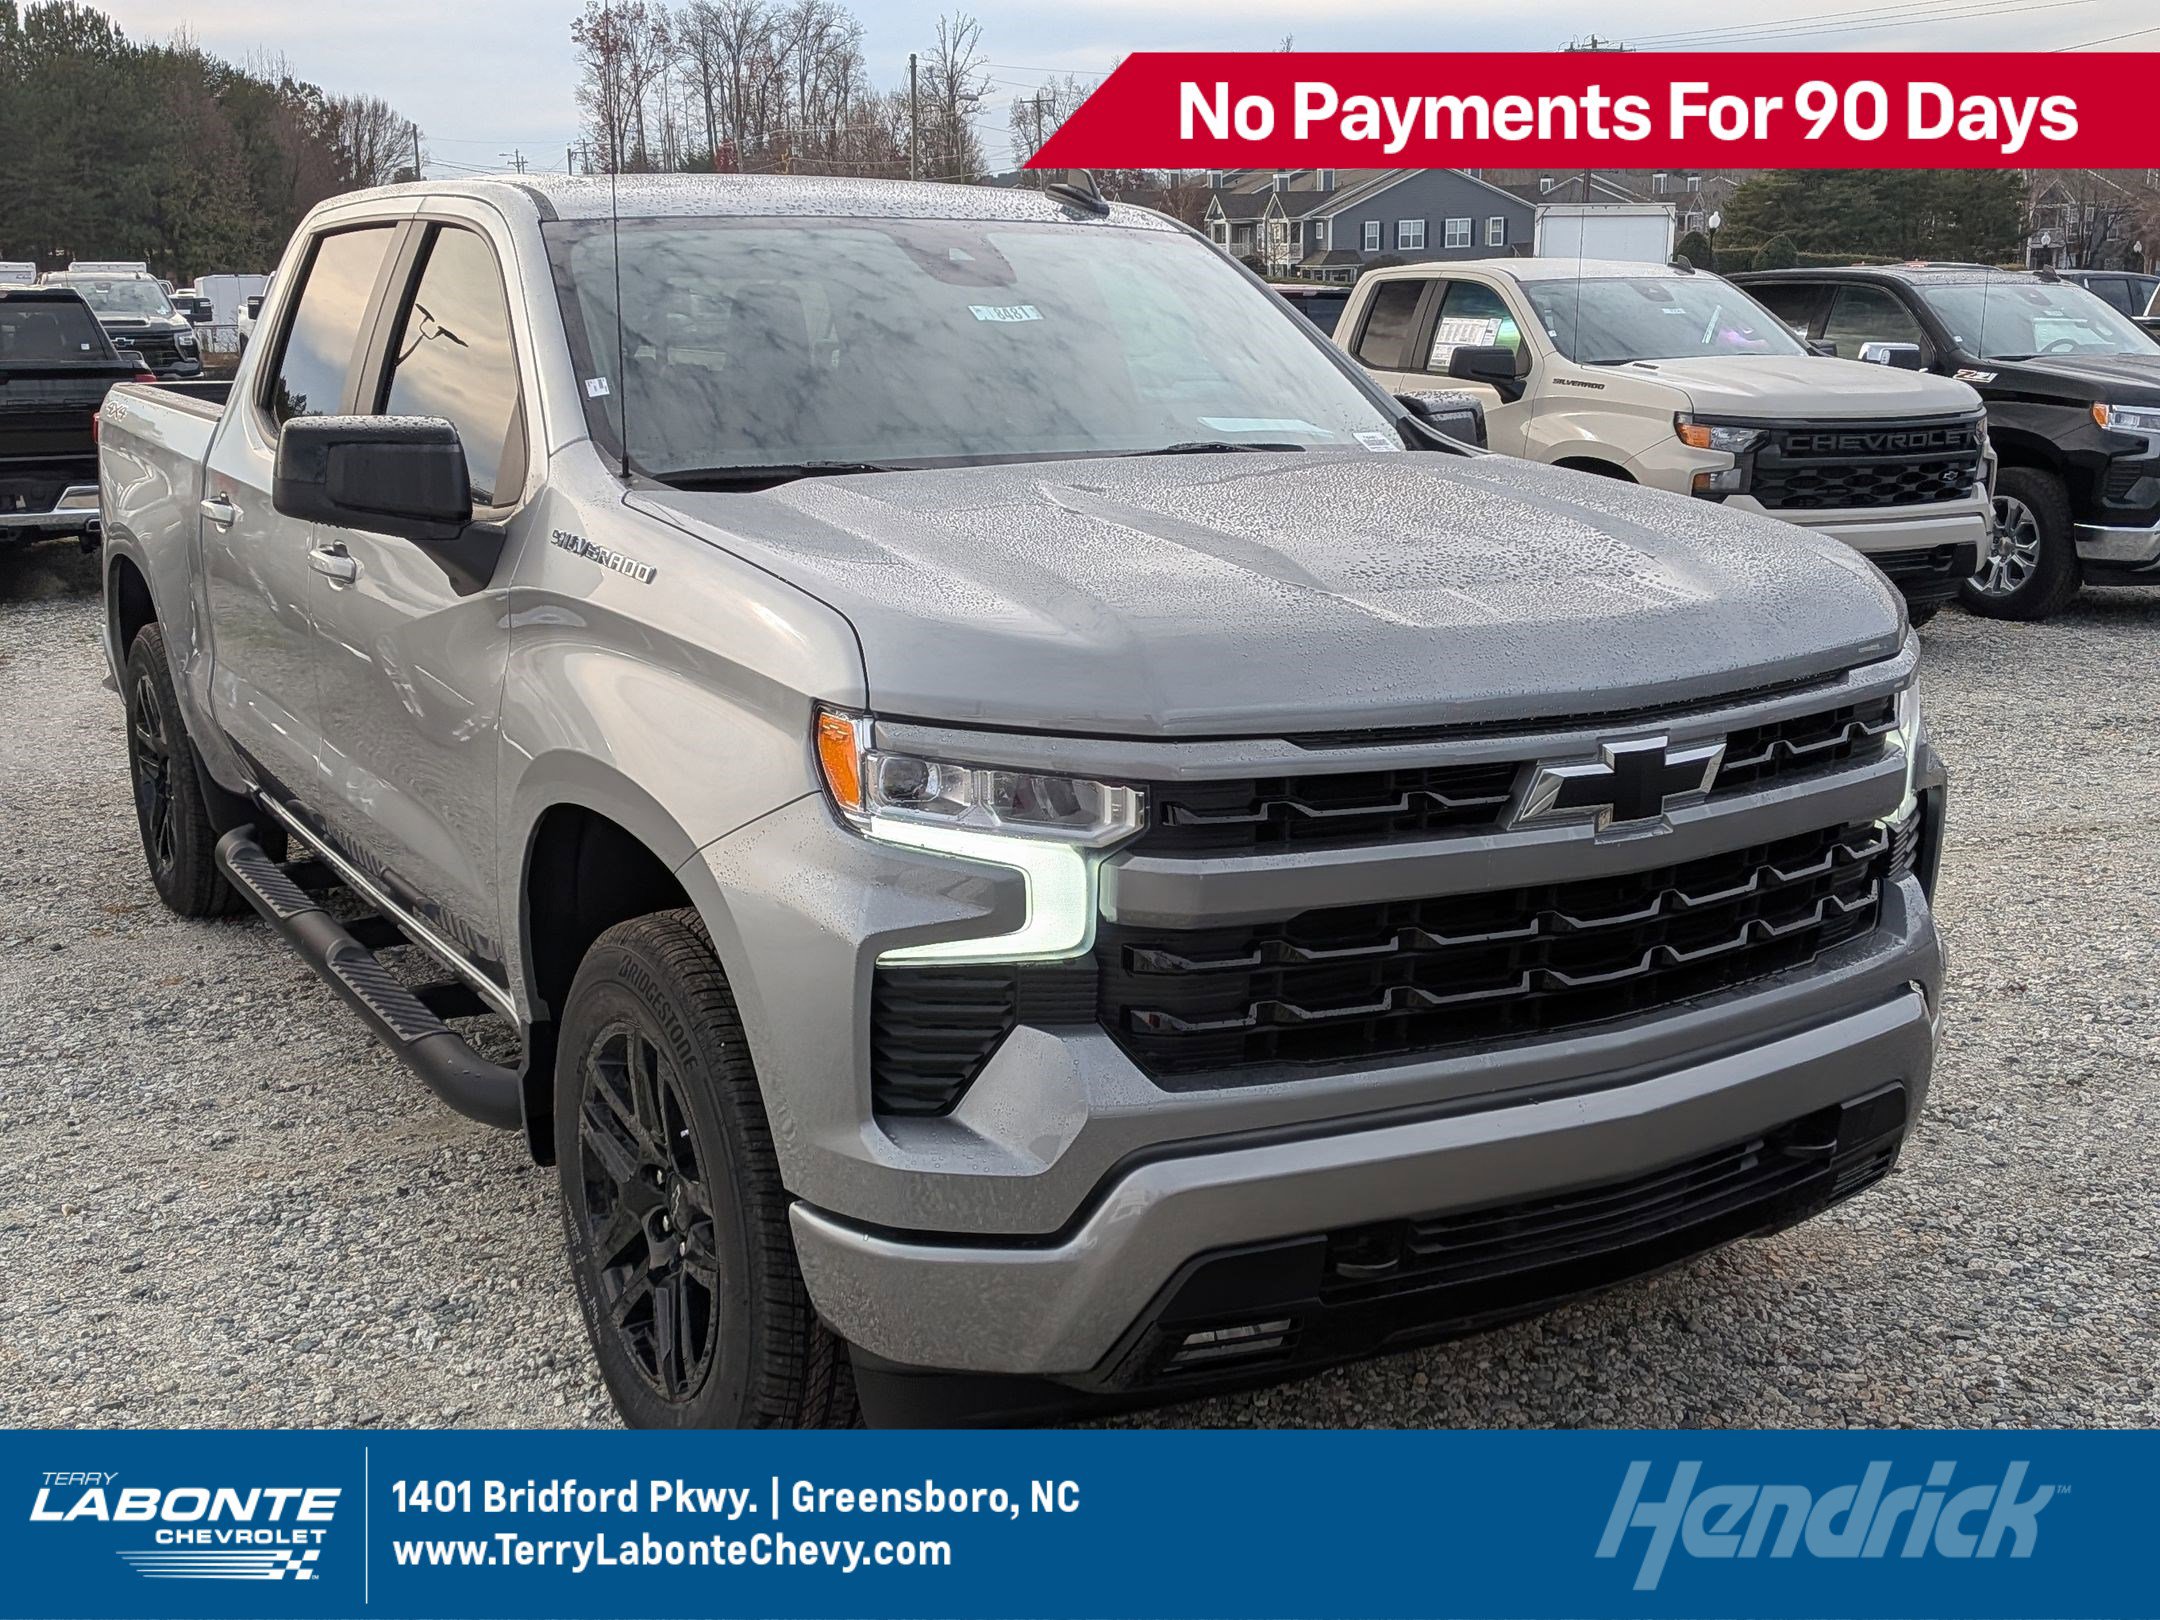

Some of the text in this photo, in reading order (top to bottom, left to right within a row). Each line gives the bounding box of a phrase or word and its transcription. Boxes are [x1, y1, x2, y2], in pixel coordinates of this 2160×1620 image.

[1552, 378, 1606, 390] SILVERADO
[1786, 429, 1975, 450] CHEVROLET
[551, 529, 657, 584] SILVERADO
[618, 954, 699, 1074] BRIDGESTONE
